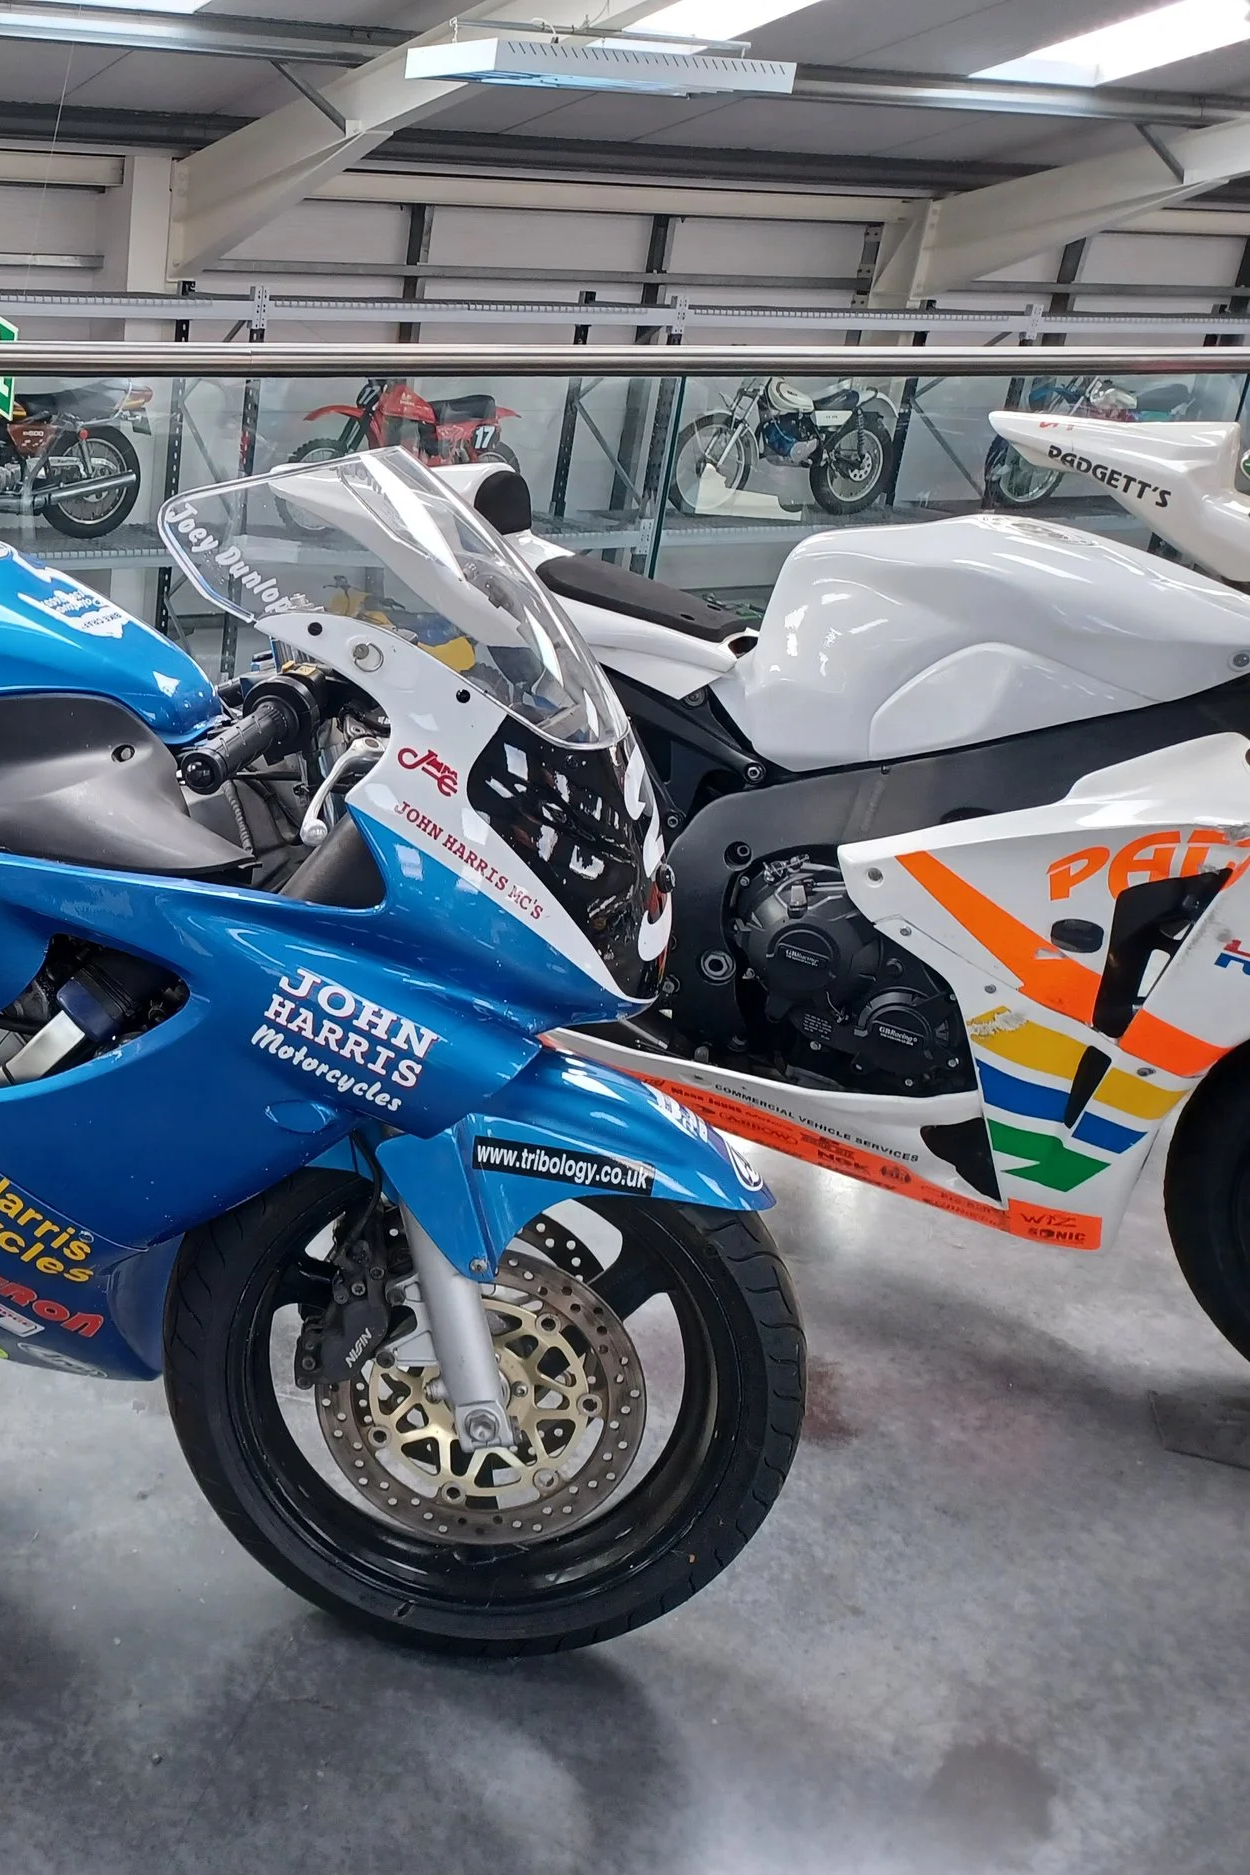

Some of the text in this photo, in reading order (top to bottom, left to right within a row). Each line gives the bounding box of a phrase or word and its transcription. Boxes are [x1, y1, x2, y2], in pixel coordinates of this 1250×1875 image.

[475, 425, 496, 449] 17
[1047, 444, 1172, 508] PADGETT'S
[165, 503, 291, 613] Joey Dunlop
[394, 801, 544, 920] JOHN HARRIS MC'S
[264, 994, 423, 1088] HARRIS
[279, 968, 439, 1059] JOHN
[251, 1024, 402, 1111] Motorcycles
[715, 1083, 795, 1118] COMMERCIAL
[798, 1115, 851, 1141] VEHICLE
[855, 1137, 919, 1163] SERVICES
[477, 1144, 648, 1189] www.tribology.co.uk
[344, 1327, 373, 1369] NISSIN
